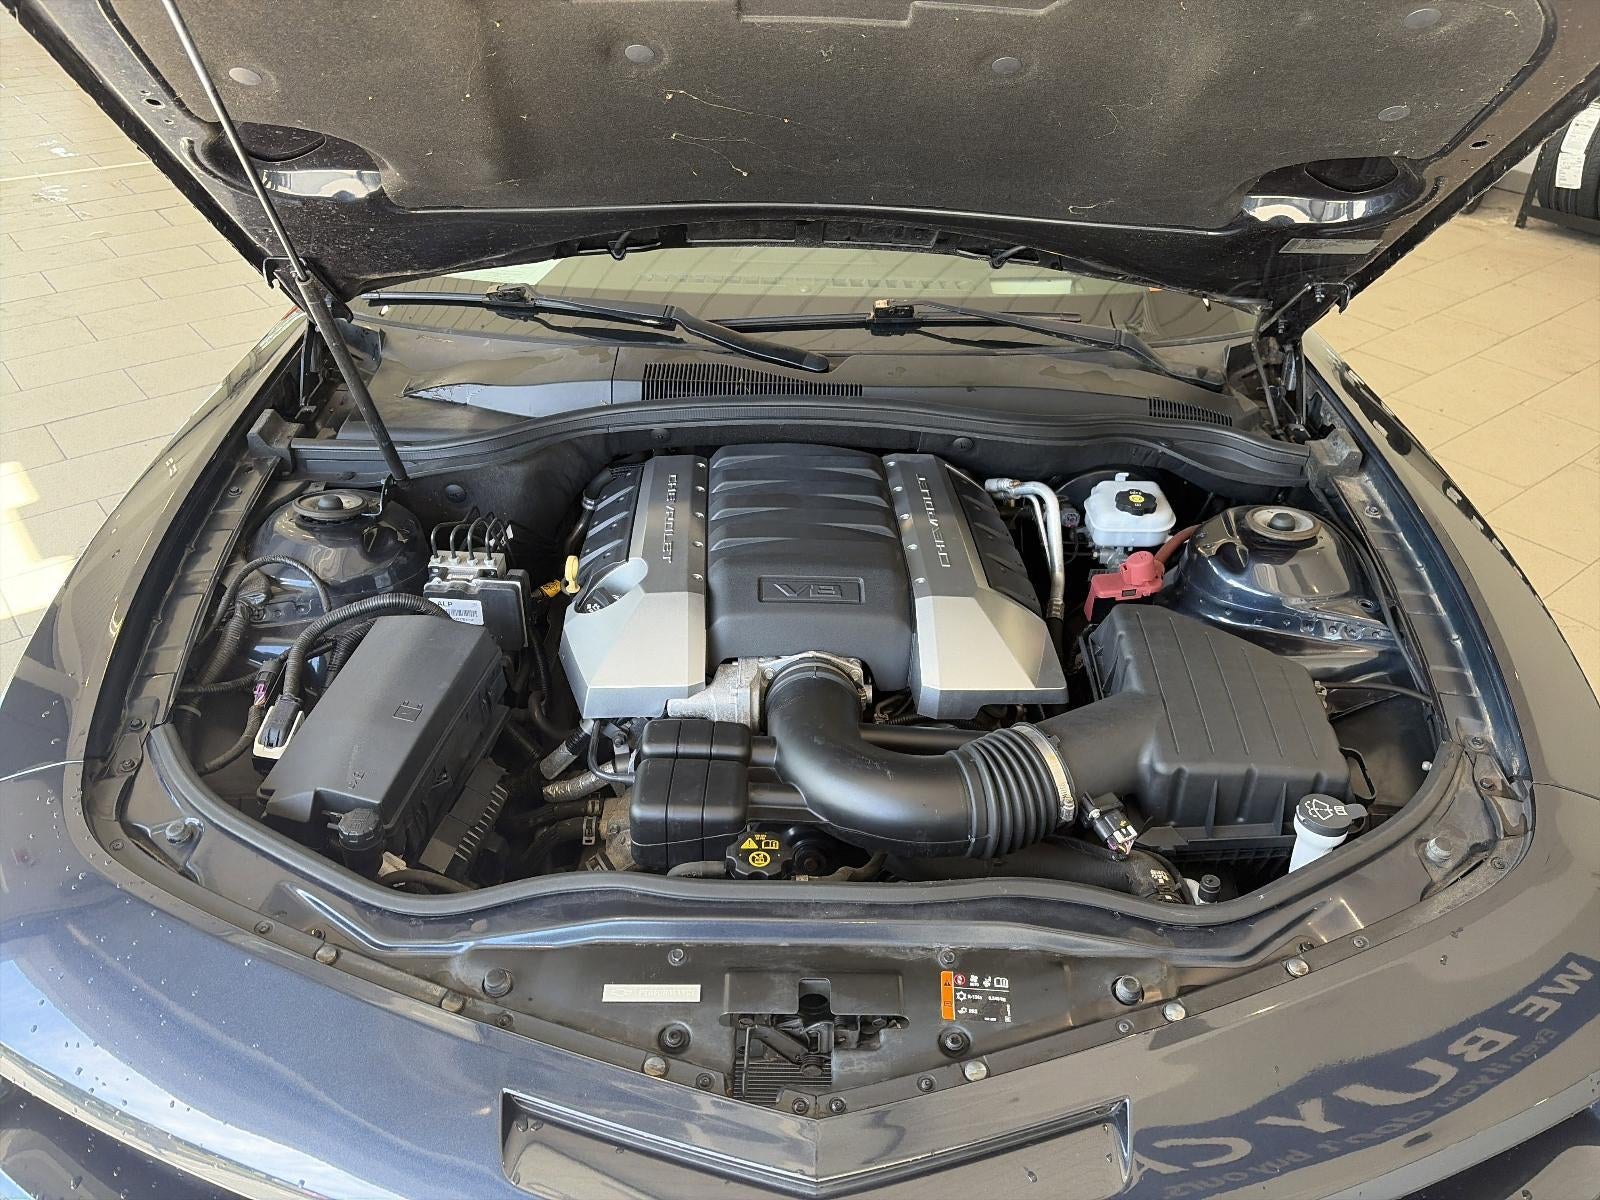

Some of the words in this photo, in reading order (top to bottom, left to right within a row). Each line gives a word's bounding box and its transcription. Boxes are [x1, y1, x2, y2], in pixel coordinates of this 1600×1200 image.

[662, 474, 678, 564] CHEVROLET
[915, 473, 952, 568] CHEVROLET
[772, 583, 843, 599] V8
